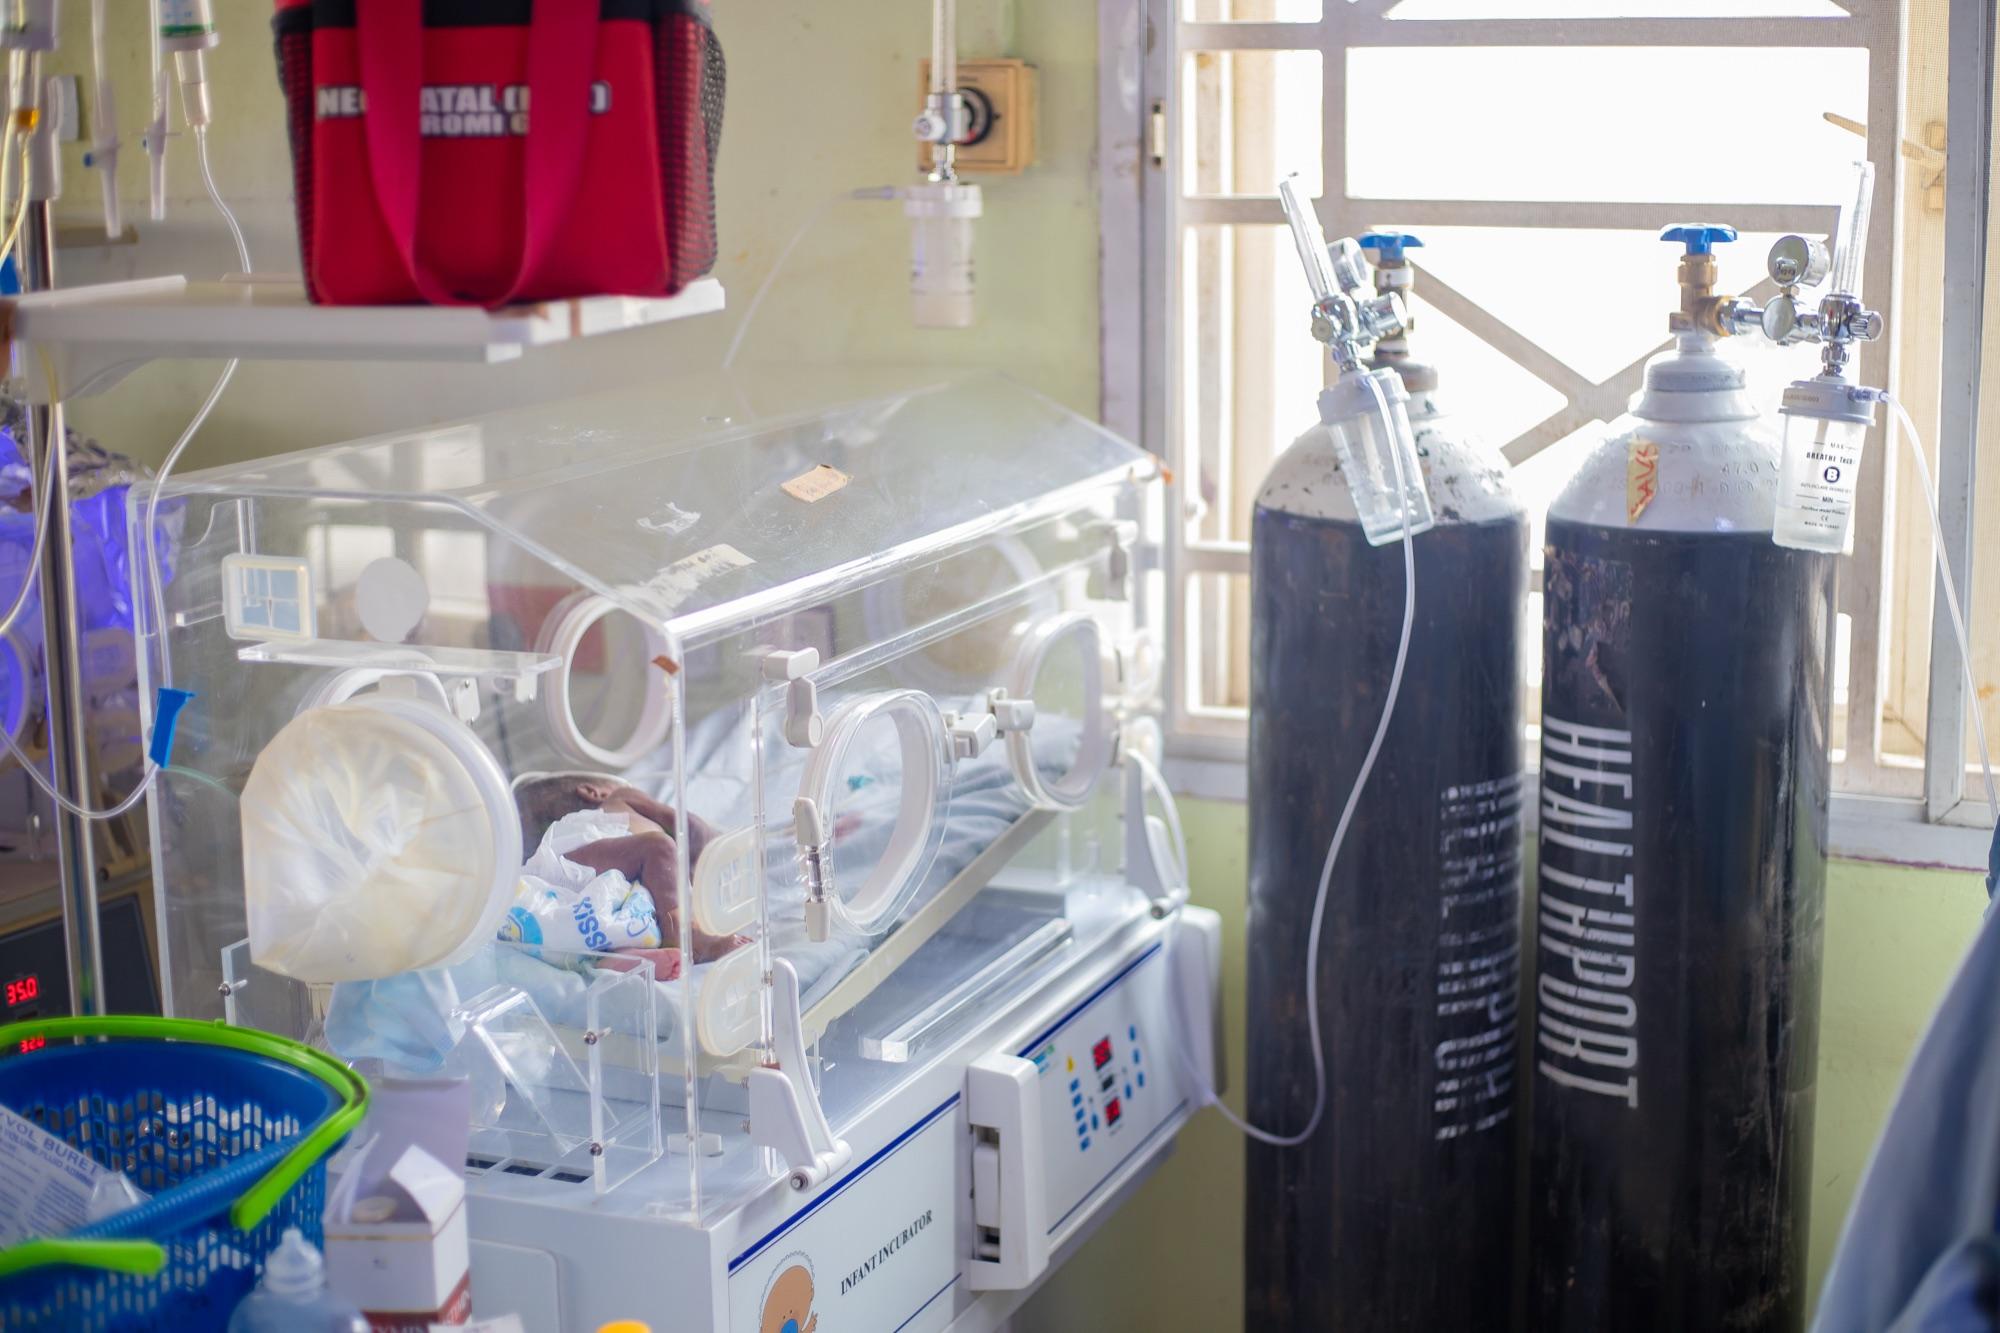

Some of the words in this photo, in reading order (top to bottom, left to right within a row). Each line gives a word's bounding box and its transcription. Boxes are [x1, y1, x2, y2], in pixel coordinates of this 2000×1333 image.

[1538, 714, 1639, 1109] HEALTHPORT
[841, 1254, 877, 1296] INFANT
[879, 1209, 933, 1265] INCUBATOR
